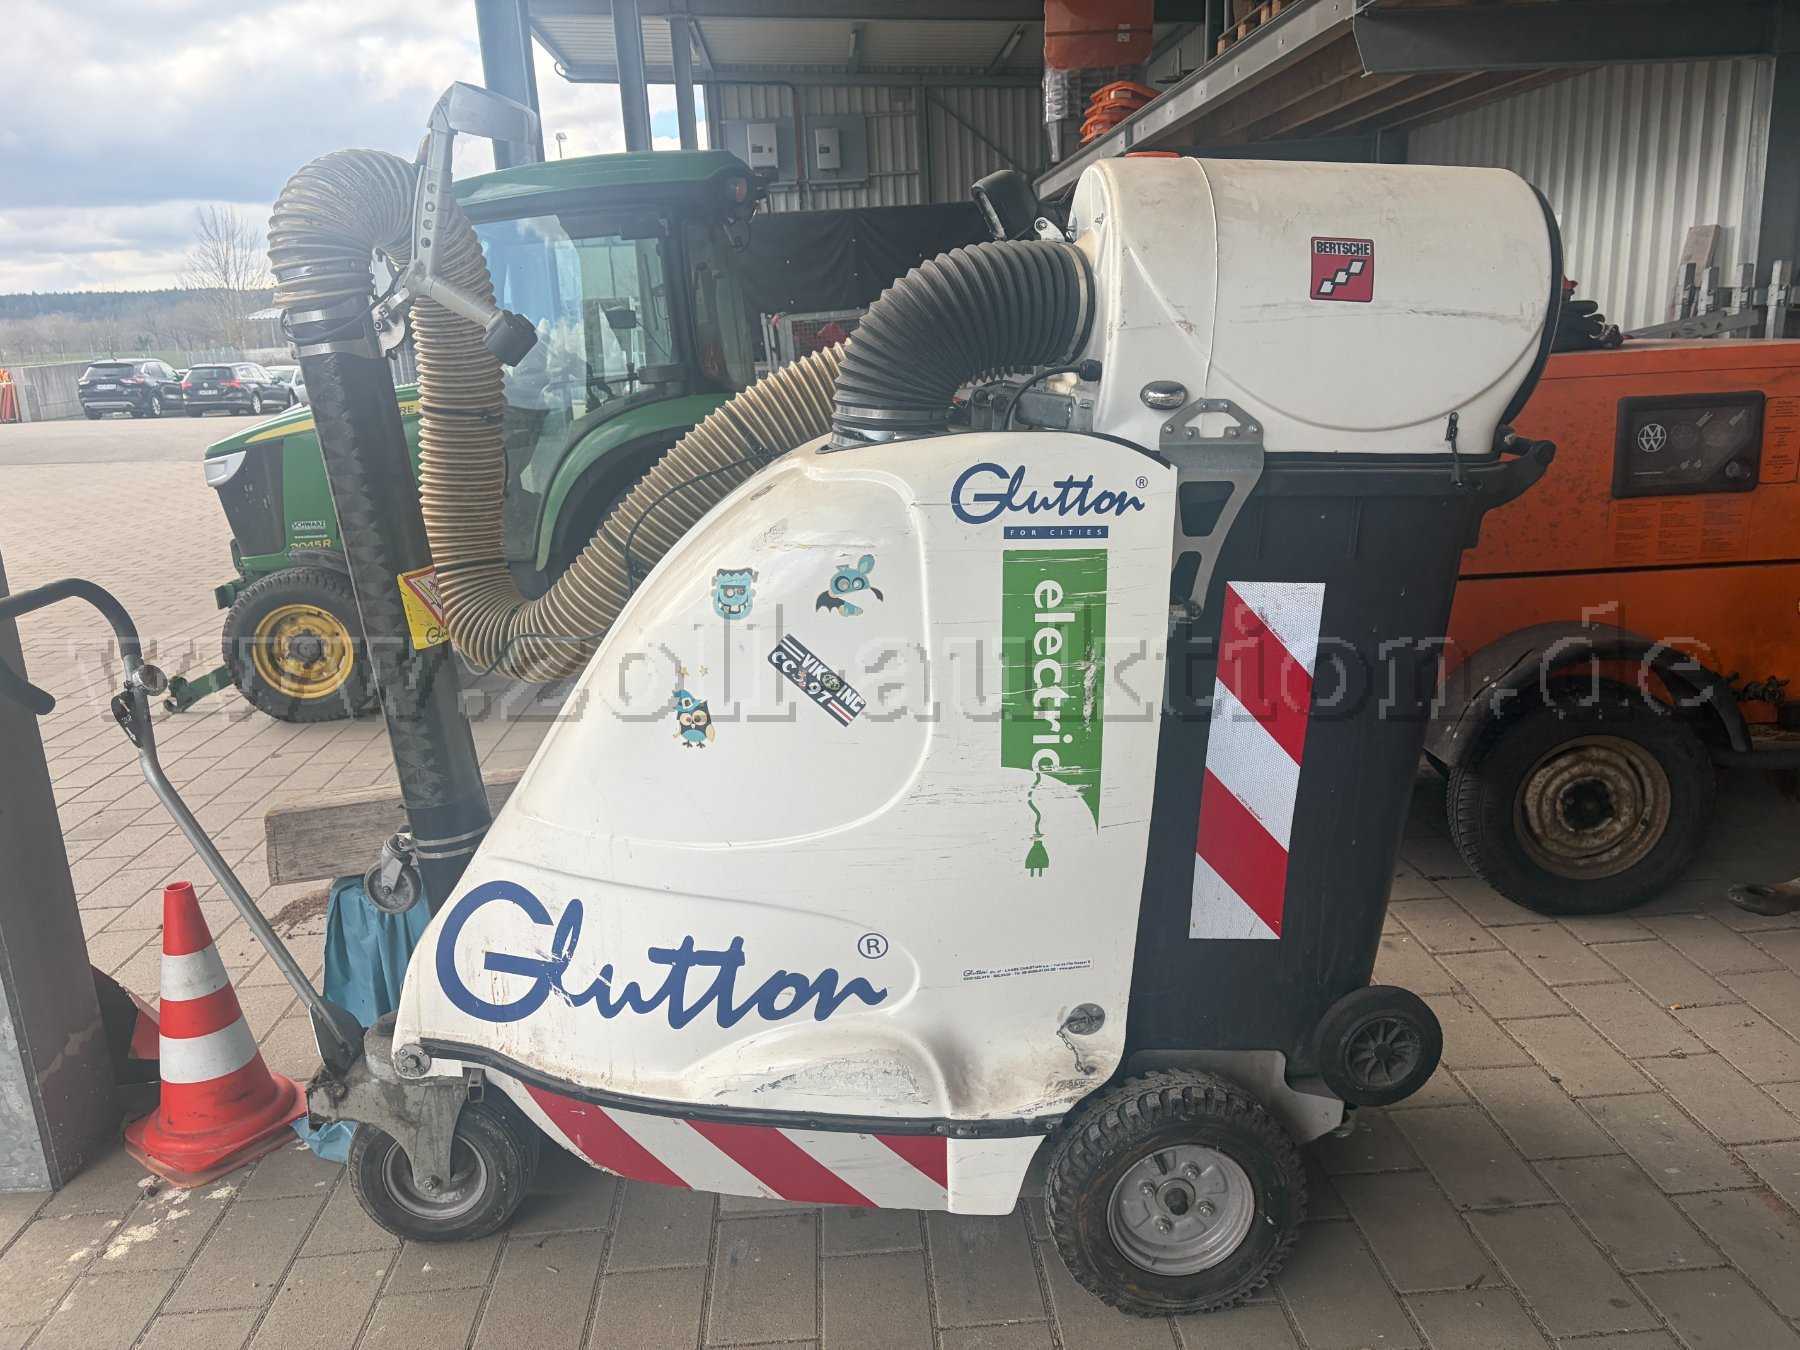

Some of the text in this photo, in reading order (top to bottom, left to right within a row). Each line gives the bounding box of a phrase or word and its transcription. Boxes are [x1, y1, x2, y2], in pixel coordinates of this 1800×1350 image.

[1316, 241, 1370, 255] BERTSCHE
[951, 462, 1145, 525] Glutton
[1050, 528, 1103, 536] CITIES
[1032, 579, 1076, 775] electric
[435, 879, 888, 1030] Glutton
